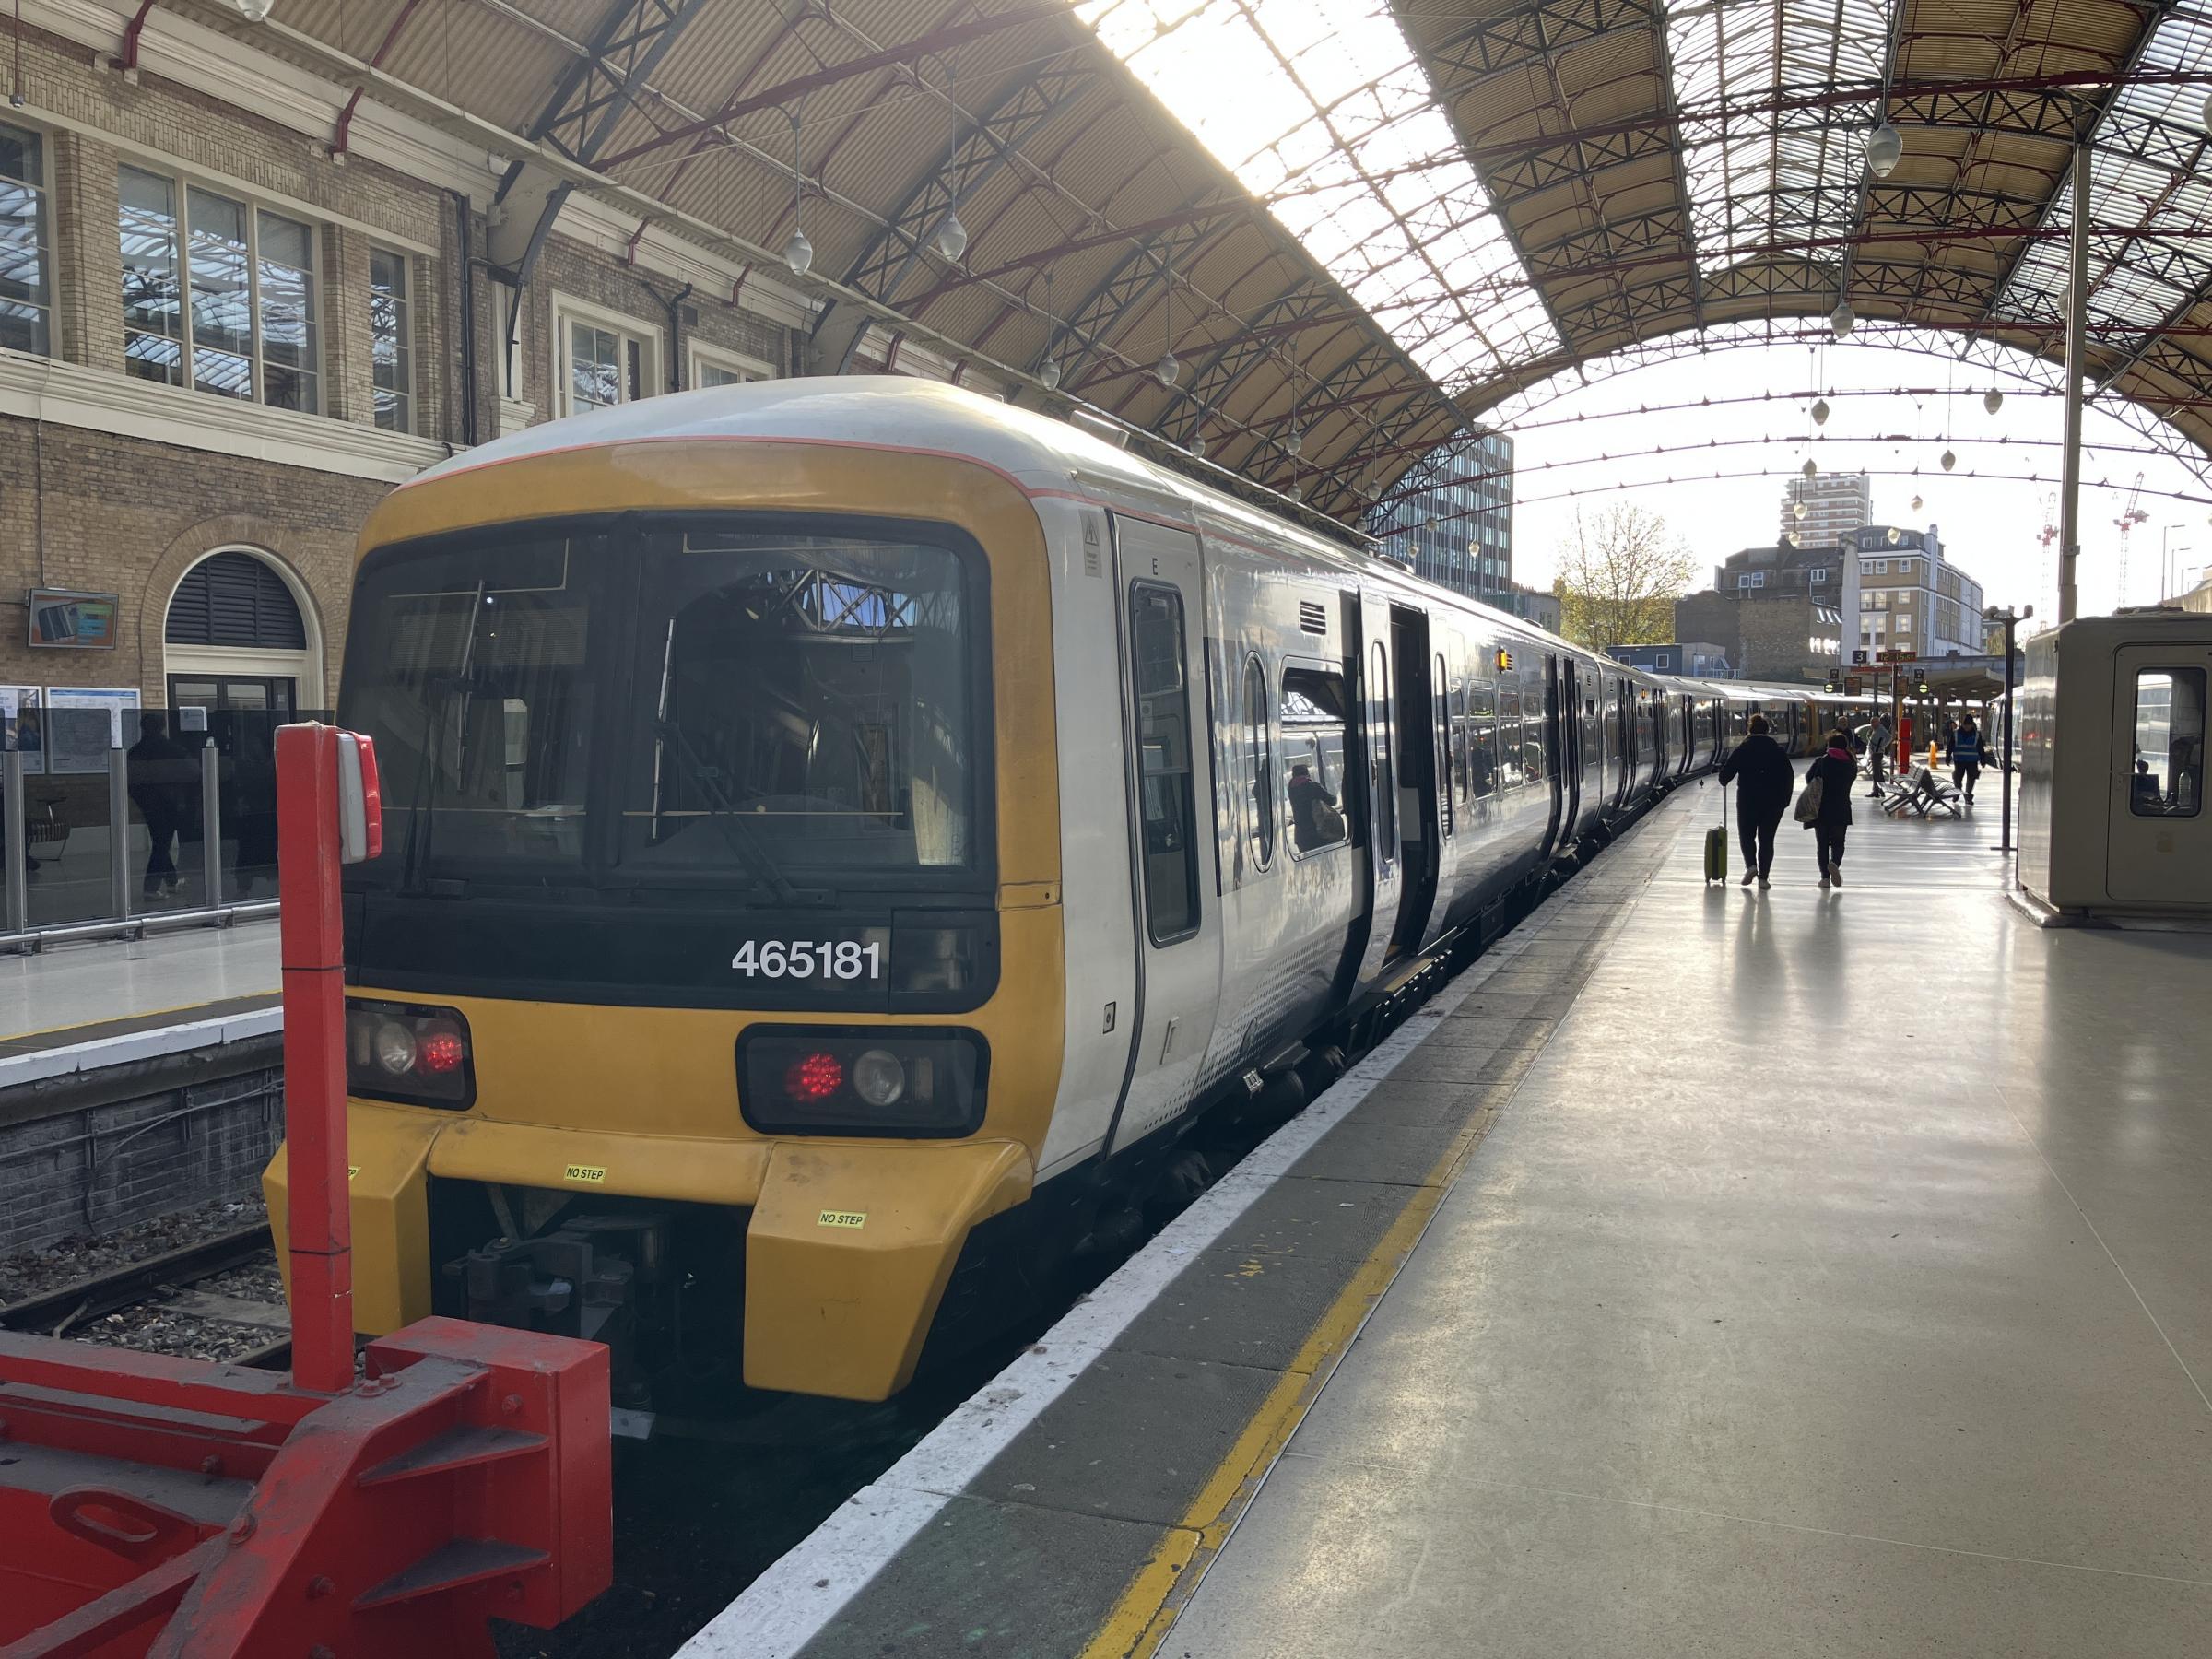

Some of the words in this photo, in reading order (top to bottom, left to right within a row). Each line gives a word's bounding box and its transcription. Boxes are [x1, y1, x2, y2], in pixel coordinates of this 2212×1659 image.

[1152, 558, 1159, 575] E
[1856, 652, 1864, 661] 3
[732, 940, 879, 980] 465181
[566, 1167, 580, 1178] NO
[581, 1169, 604, 1180] STEP
[820, 1213, 836, 1223] NO
[837, 1215, 863, 1225] STEP
